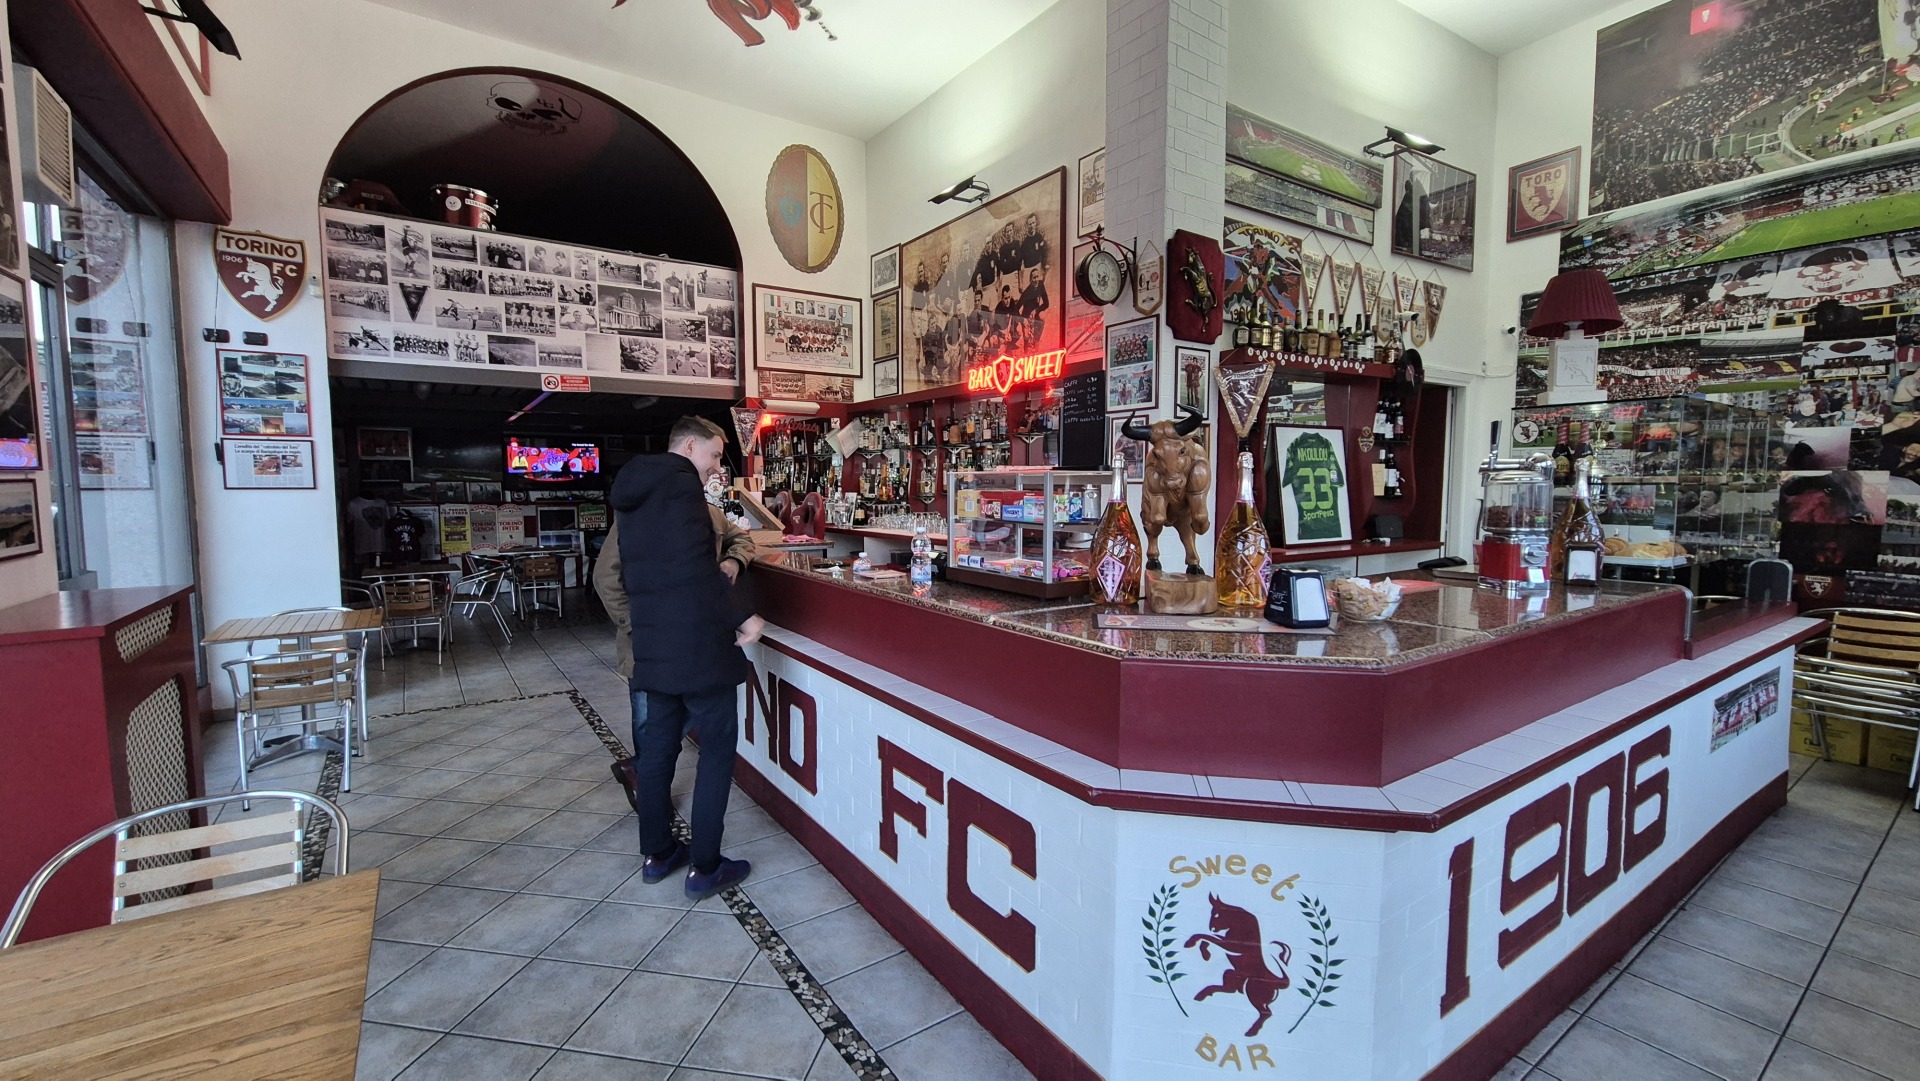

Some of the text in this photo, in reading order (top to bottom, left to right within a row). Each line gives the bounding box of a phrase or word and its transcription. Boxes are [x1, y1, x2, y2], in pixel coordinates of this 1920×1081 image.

[1526, 169, 1562, 188] TORO
[221, 235, 298, 258] TORINO
[1237, 228, 1280, 245] TORINO
[222, 254, 243, 264] 1906
[272, 262, 298, 277] FC
[1629, 326, 1664, 337] STORIA
[1684, 315, 1768, 332] APPARTIENE
[968, 348, 1067, 391] BAR SWEET
[1297, 447, 1328, 461] NKOULOU
[1297, 467, 1334, 510] 33
[877, 735, 1037, 974] FC
[1169, 854, 1301, 902] Sweet
[1440, 725, 1671, 1019] 1906
[1194, 1033, 1276, 1072] BAR
